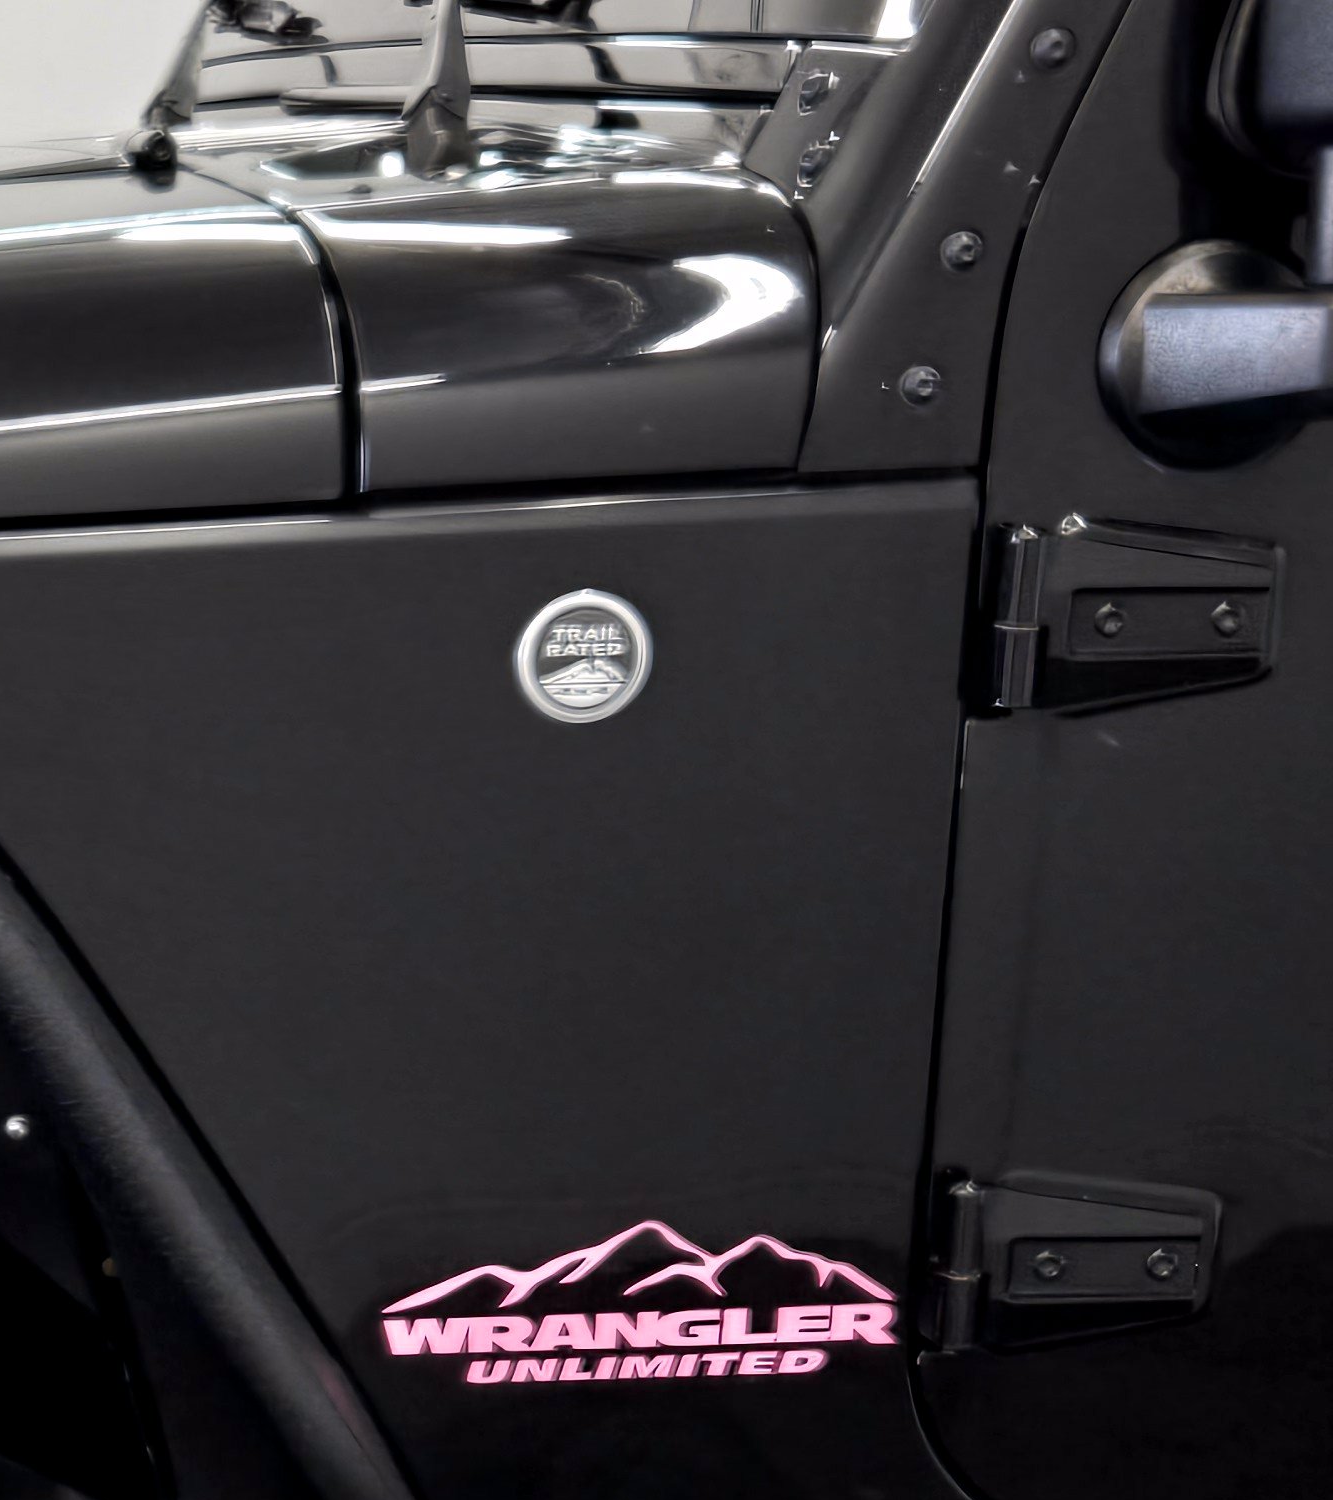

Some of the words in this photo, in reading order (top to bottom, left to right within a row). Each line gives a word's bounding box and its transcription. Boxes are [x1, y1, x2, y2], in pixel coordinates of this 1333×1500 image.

[550, 624, 625, 642] TRAIL
[546, 643, 626, 657] RATED
[382, 1302, 899, 1356] WRANGLER
[466, 1348, 829, 1384] UNLIMITED
